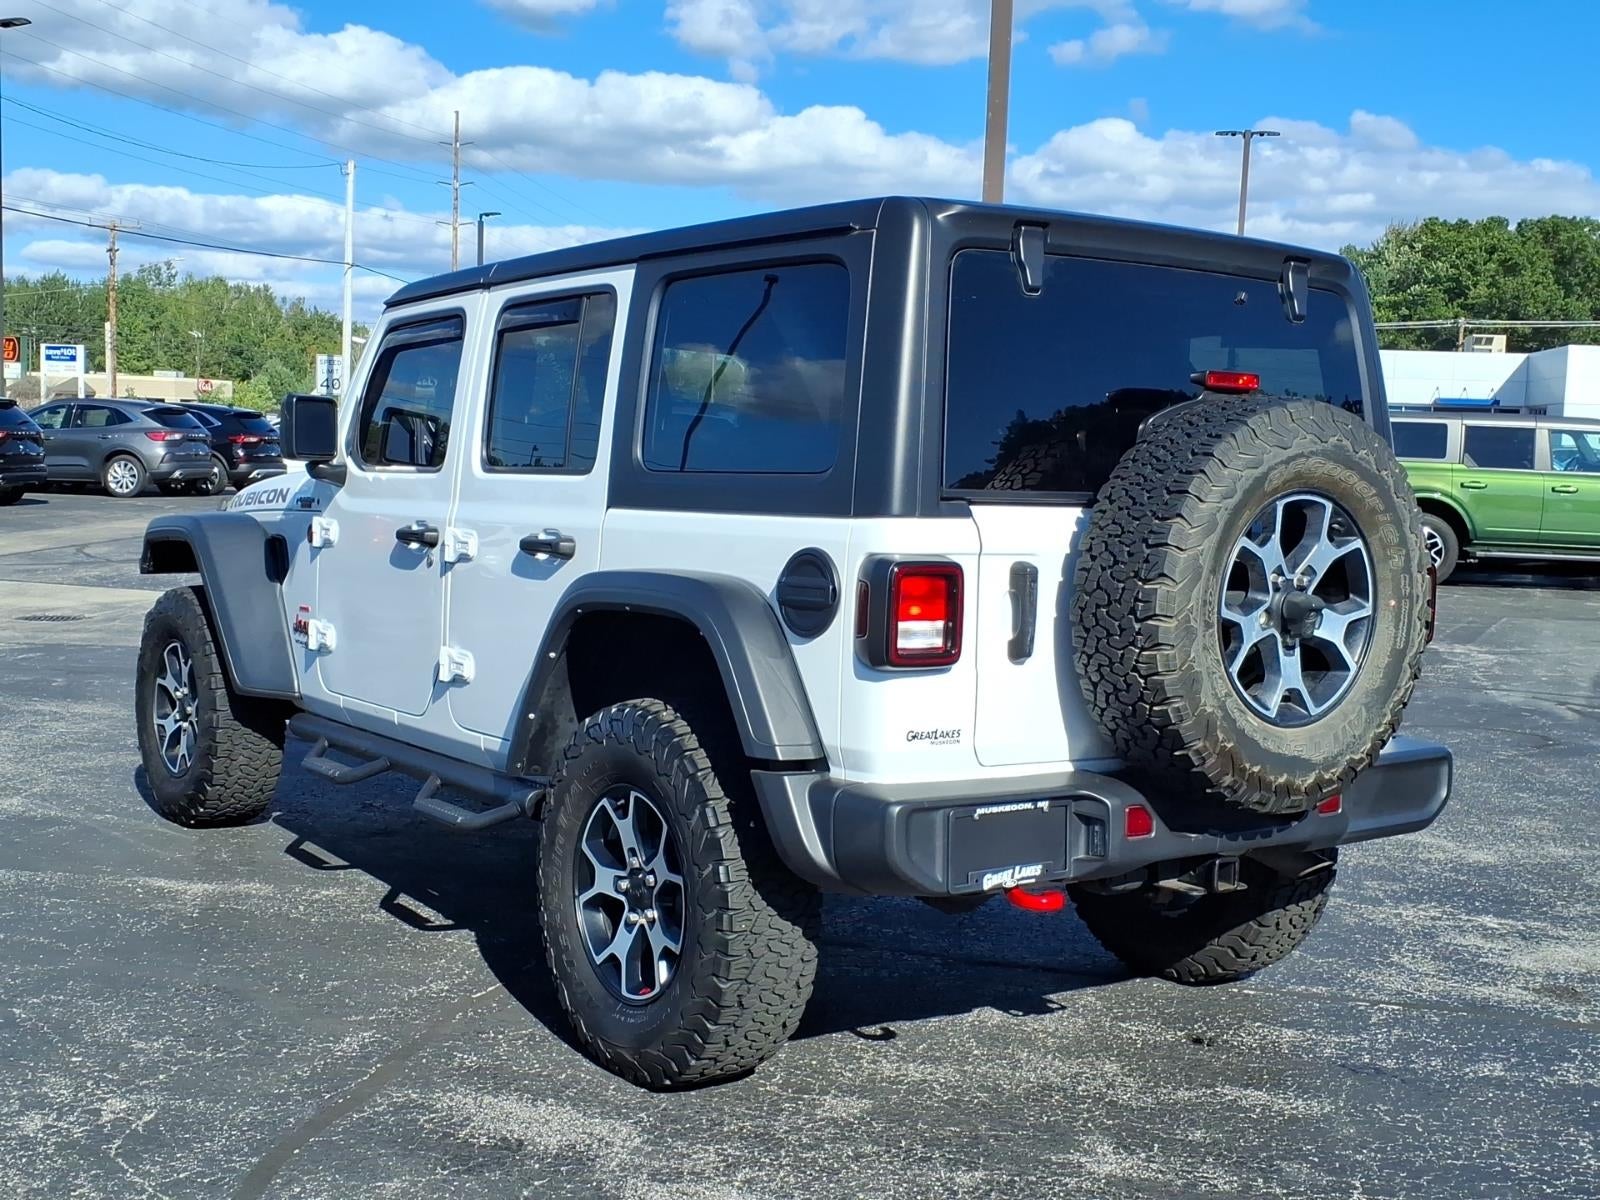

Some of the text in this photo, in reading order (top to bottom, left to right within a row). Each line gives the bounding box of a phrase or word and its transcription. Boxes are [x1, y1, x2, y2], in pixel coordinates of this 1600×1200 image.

[320, 378, 341, 390] 40
[229, 487, 290, 510] RUBICON
[1037, 801, 1049, 809] MI
